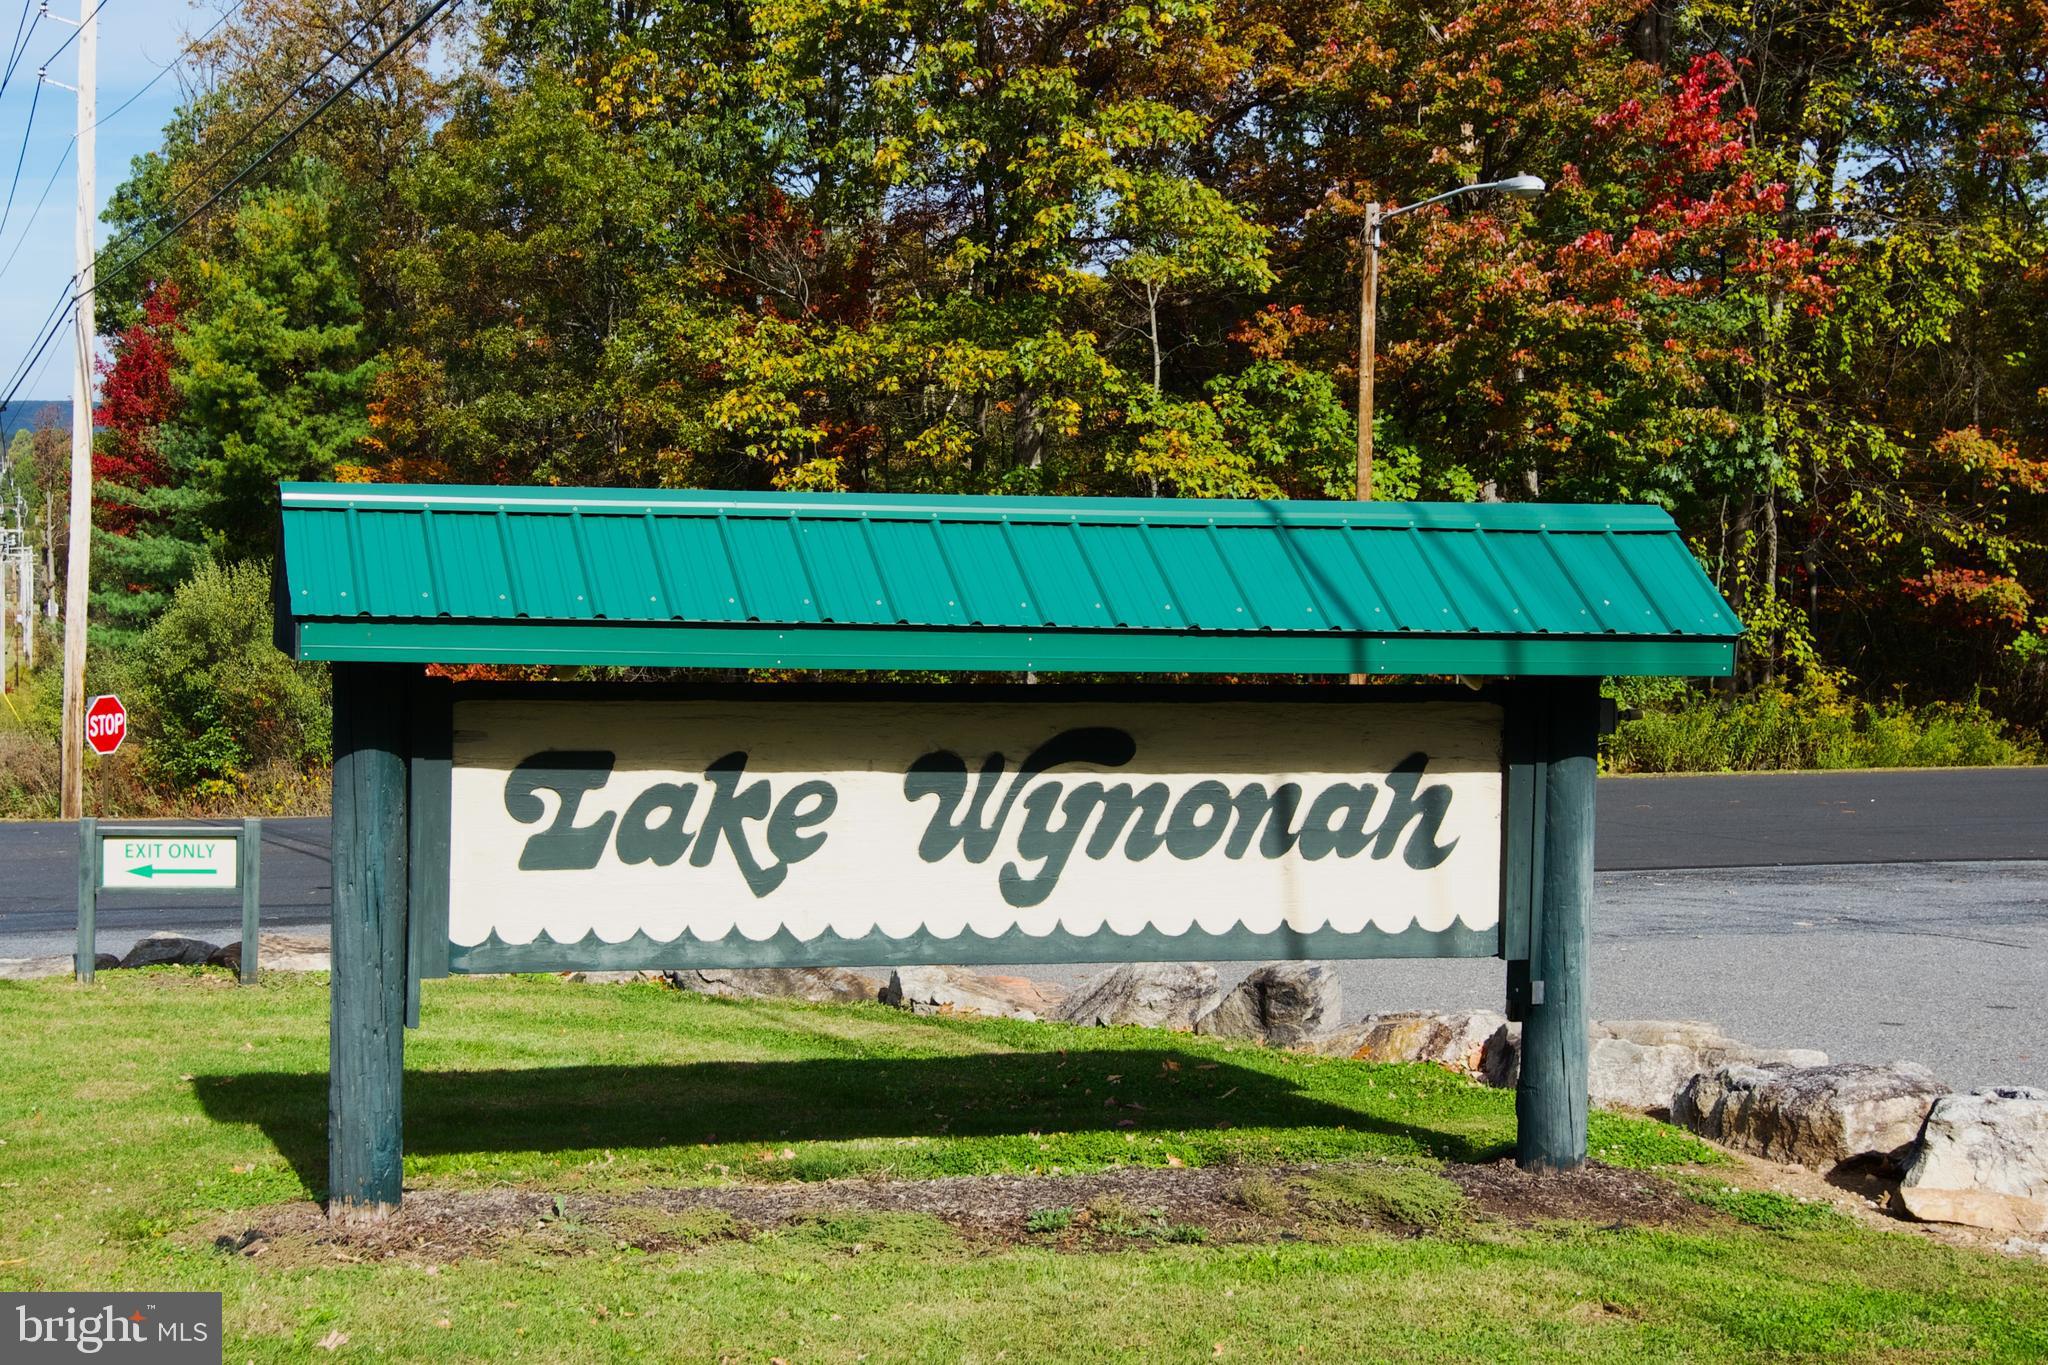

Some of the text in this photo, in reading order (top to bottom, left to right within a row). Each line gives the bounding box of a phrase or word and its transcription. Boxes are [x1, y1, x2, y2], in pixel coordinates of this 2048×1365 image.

[89, 713, 125, 737] STOP
[504, 727, 1460, 908] Lake Wymonah
[125, 843, 216, 859] EXIT ONLY
